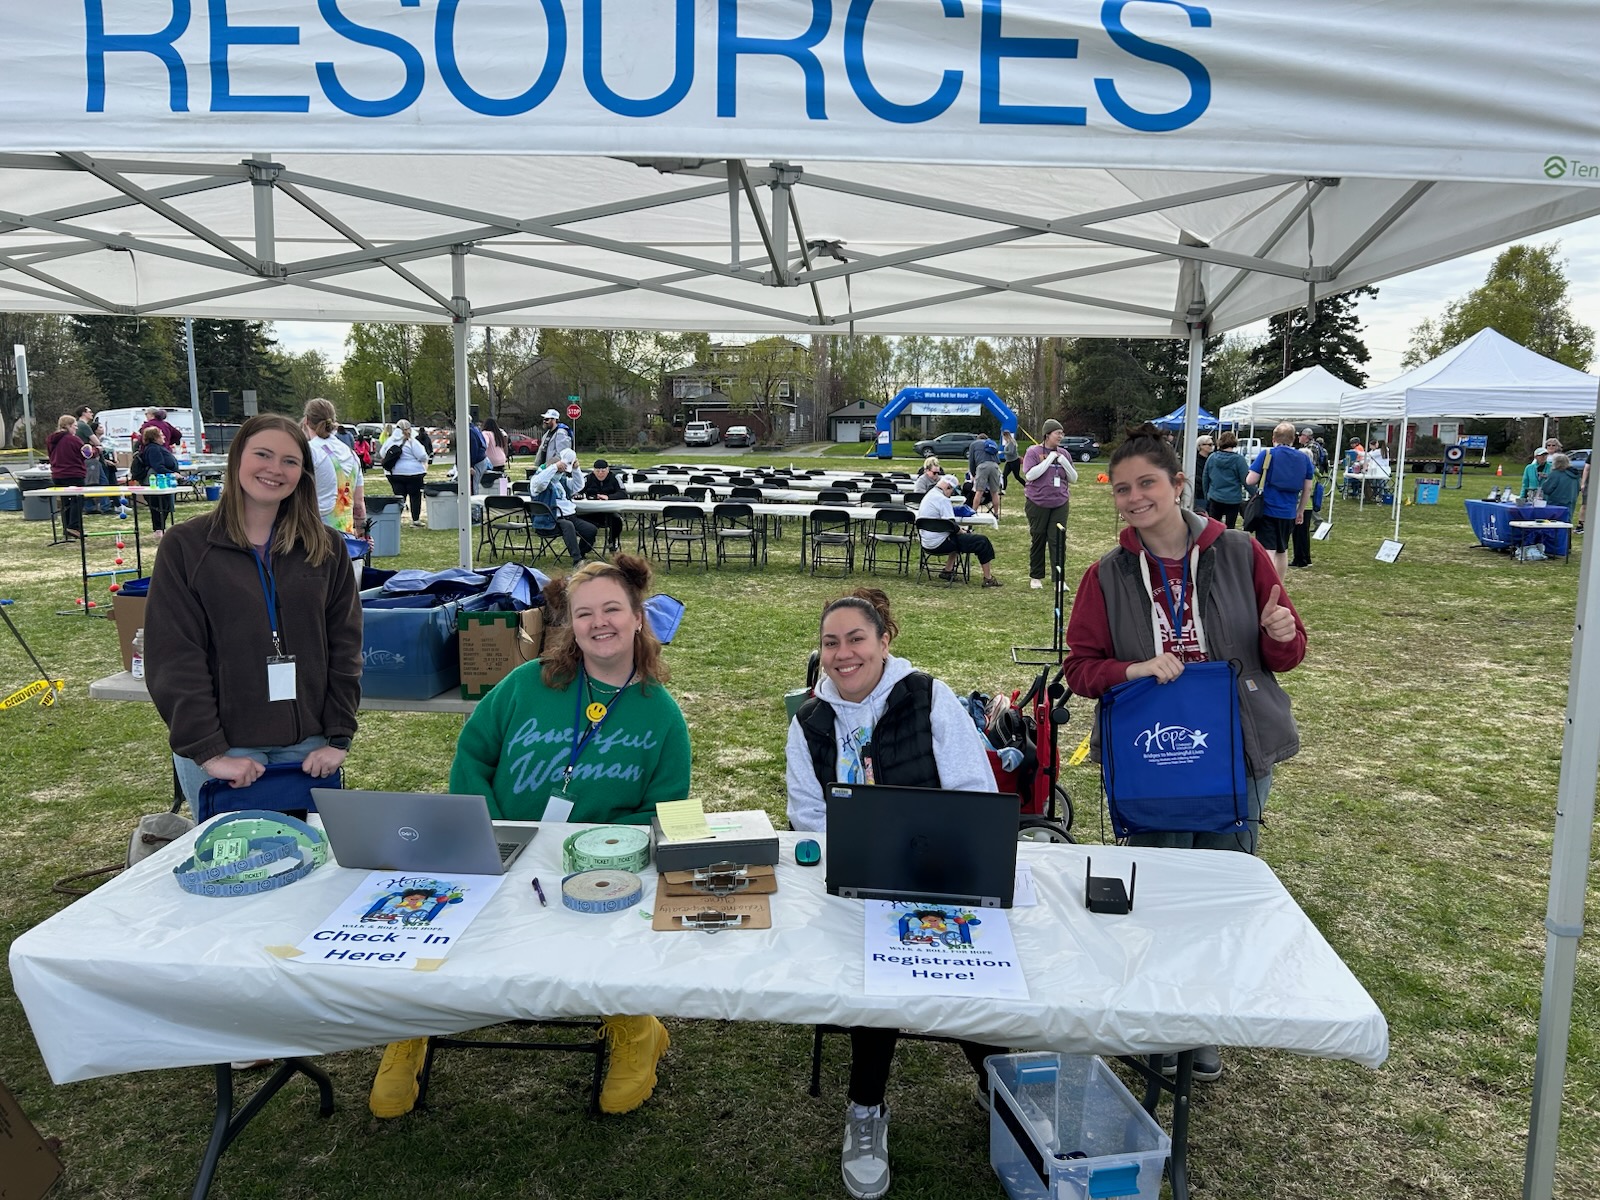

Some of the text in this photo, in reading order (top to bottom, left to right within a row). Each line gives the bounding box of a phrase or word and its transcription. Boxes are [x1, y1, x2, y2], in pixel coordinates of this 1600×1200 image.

[86, 0, 1212, 132] RESOURCES
[362, 646, 391, 665] Hope
[508, 718, 657, 756] Powerful
[1134, 722, 1188, 752] Hope
[510, 747, 645, 794] Woman
[377, 877, 427, 888] Hope
[313, 930, 400, 942] Check
[423, 934, 450, 944] In
[324, 949, 407, 961] Here!
[873, 953, 1011, 967] Registration
[912, 969, 975, 980] Here!
